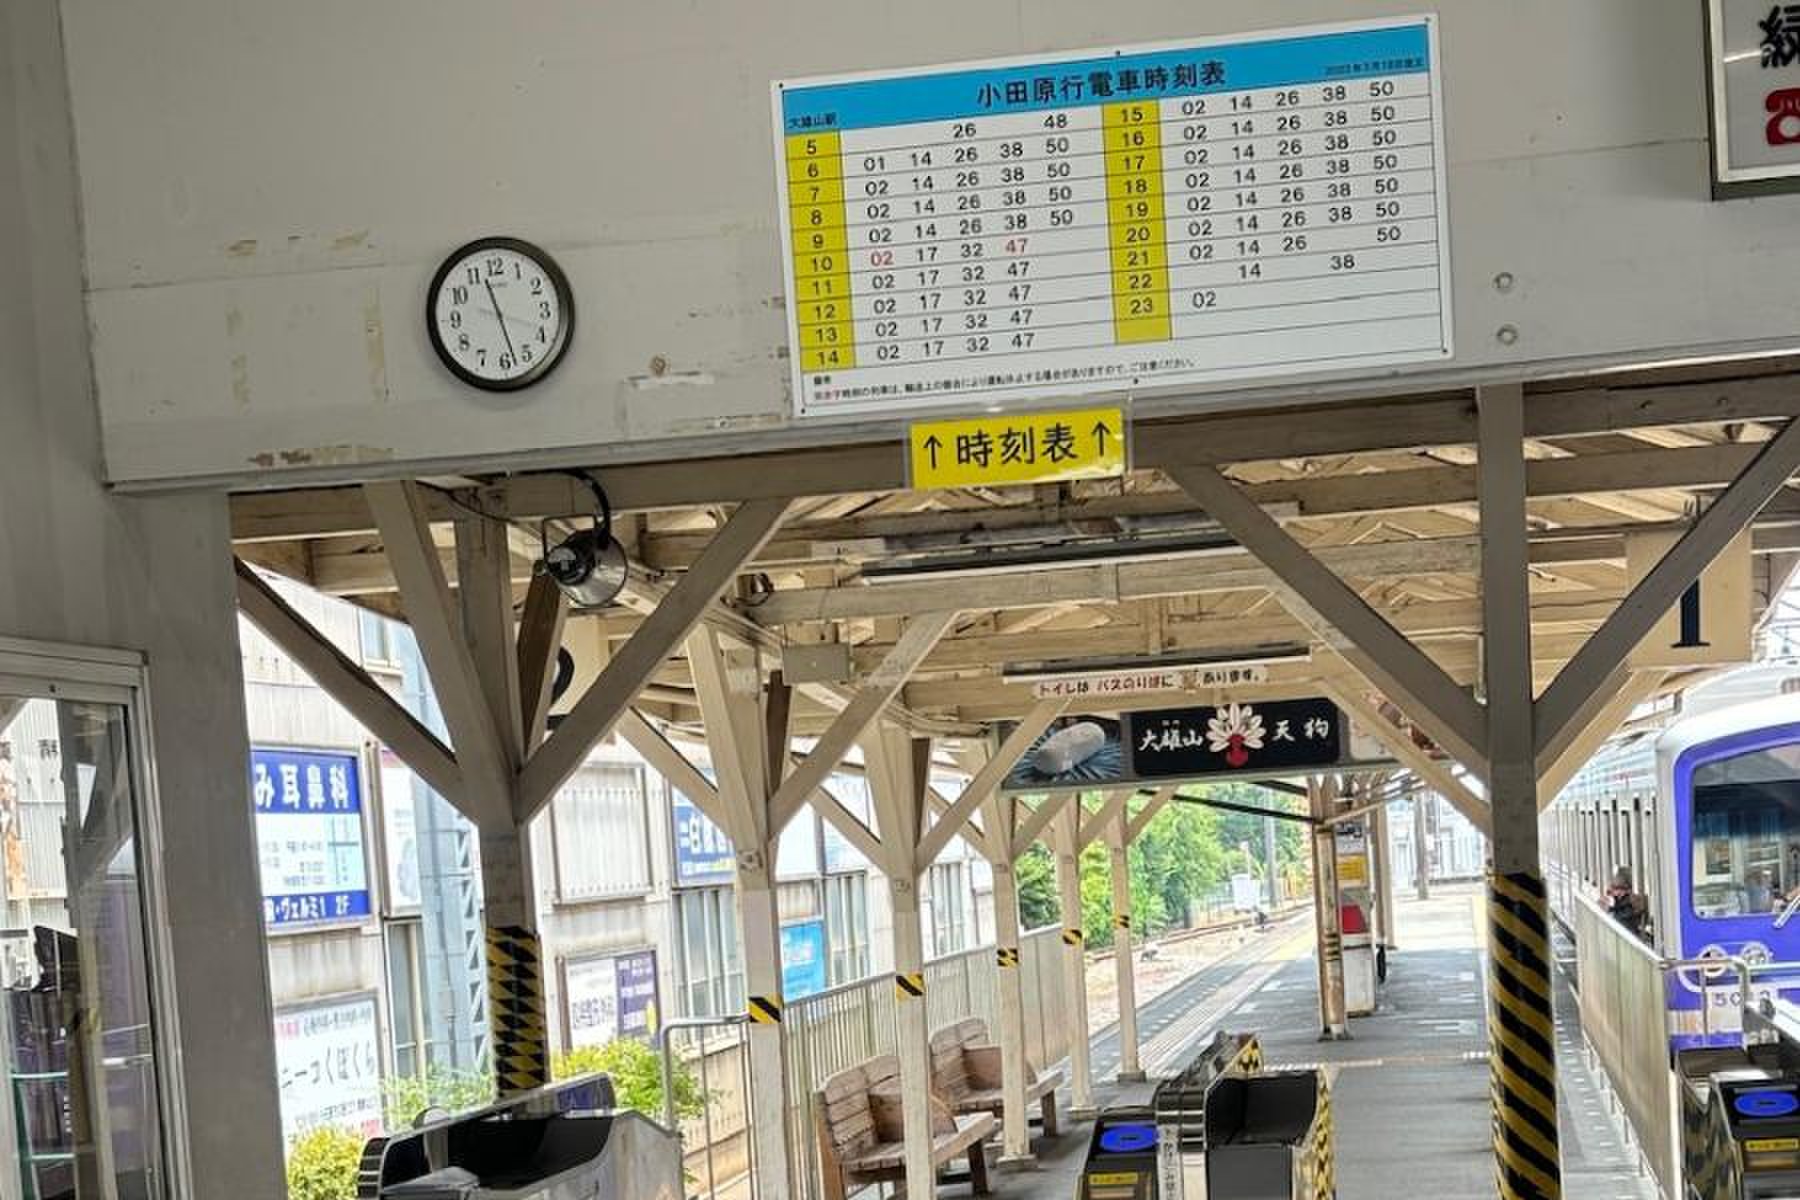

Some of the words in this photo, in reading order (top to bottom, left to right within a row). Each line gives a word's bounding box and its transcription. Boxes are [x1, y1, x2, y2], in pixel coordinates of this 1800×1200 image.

[976, 59, 1228, 109] 小田原行電車時刻表
[1121, 107, 1143, 123] 15
[1181, 99, 1206, 116] 02
[1231, 95, 1252, 111] 14
[1275, 90, 1299, 107] 26
[1322, 85, 1347, 102] 38
[1369, 81, 1394, 97] 50
[806, 139, 817, 155] 5
[953, 122, 977, 139] 26
[1043, 113, 1068, 129] 48
[1123, 130, 1145, 147] 16
[1183, 125, 1207, 140] 02
[1231, 119, 1254, 135] 14
[1277, 115, 1301, 131] 26
[1324, 110, 1348, 127] 38
[1371, 105, 1395, 122] 50
[807, 163, 819, 178] 6
[863, 156, 885, 172] 01
[911, 151, 932, 166] 14
[954, 146, 978, 163] 26
[1000, 141, 1024, 159] 38
[1046, 137, 1069, 155] 50
[1124, 155, 1145, 171] 17
[1184, 149, 1208, 165] 02
[1232, 143, 1255, 160] 14
[1277, 138, 1303, 156] 26
[1325, 134, 1349, 151] 38
[1372, 130, 1397, 146] 50
[810, 186, 820, 201] 7
[864, 180, 889, 197] 02
[912, 175, 934, 190] 14
[956, 171, 979, 188] 26
[1001, 167, 1025, 183] 38
[1047, 162, 1071, 179] 50
[1124, 178, 1148, 194] 18
[1185, 172, 1209, 189] 02
[1234, 167, 1256, 184] 14
[1279, 163, 1303, 180] 26
[1326, 159, 1350, 175] 38
[1373, 154, 1398, 171] 50
[810, 209, 823, 226] 8
[866, 203, 890, 220] 02
[914, 199, 935, 213] 14
[957, 195, 980, 211] 26
[1003, 190, 1026, 206] 38
[1048, 186, 1073, 202] 50
[1125, 201, 1149, 217] 19
[1187, 196, 1211, 211] 02
[1235, 191, 1258, 207] 14
[1281, 187, 1305, 203] 26
[1327, 182, 1352, 198] 38
[1375, 177, 1399, 194] 50
[812, 234, 824, 249] 9
[868, 227, 892, 243] 02
[915, 223, 937, 239] 14
[959, 218, 982, 235] 26
[1005, 213, 1027, 231] 38
[1050, 208, 1073, 227] 50
[1126, 226, 1151, 243] 20
[1188, 219, 1213, 237] 02
[1236, 215, 1259, 231] 14
[1281, 210, 1306, 228] 26
[1328, 206, 1353, 223] 38
[1375, 201, 1400, 218] 50
[812, 256, 833, 272] 10
[870, 250, 894, 267] 02
[917, 246, 938, 262] 17
[960, 242, 983, 259] 32
[1005, 237, 1028, 253] 47
[1127, 250, 1149, 267] 21
[1189, 244, 1213, 261] 02
[1237, 239, 1260, 255] 14
[1283, 235, 1307, 252] 26
[1376, 225, 1401, 243] 50
[467, 267, 481, 285] 11
[486, 257, 504, 277] 12
[514, 262, 522, 280] 1
[812, 279, 832, 295] 11
[871, 273, 895, 290] 02
[918, 269, 939, 285] 17
[962, 265, 985, 282] 32
[1007, 261, 1030, 277] 47
[1129, 273, 1152, 290] 22
[1239, 263, 1261, 279] 14
[1331, 254, 1355, 271] 38
[451, 286, 468, 305] 10
[530, 277, 542, 295] 2
[815, 303, 836, 319] 12
[873, 298, 897, 315] 02
[919, 293, 941, 309] 17
[964, 288, 987, 307] 32
[1008, 284, 1031, 301] 47
[1130, 296, 1153, 315] 23
[1192, 291, 1217, 309] 02
[450, 310, 461, 329] 9
[539, 301, 551, 319] 3
[815, 326, 838, 342] 13
[875, 321, 897, 337] 02
[922, 317, 943, 333] 17
[965, 313, 988, 330] 32
[1010, 308, 1033, 325] 47
[458, 333, 470, 351] 8
[535, 326, 545, 344] 4
[818, 350, 839, 365] 14
[877, 344, 900, 360] 02
[924, 340, 944, 355] 17
[967, 336, 989, 353] 32
[1011, 332, 1035, 348] 47
[476, 348, 487, 367] 7
[500, 353, 511, 370] 6
[521, 344, 533, 362] 5
[955, 422, 1079, 469] 時刻表
[1038, 681, 1090, 698] トイレは
[1139, 728, 1204, 752] 大雄山
[1272, 717, 1330, 742] 天狗
